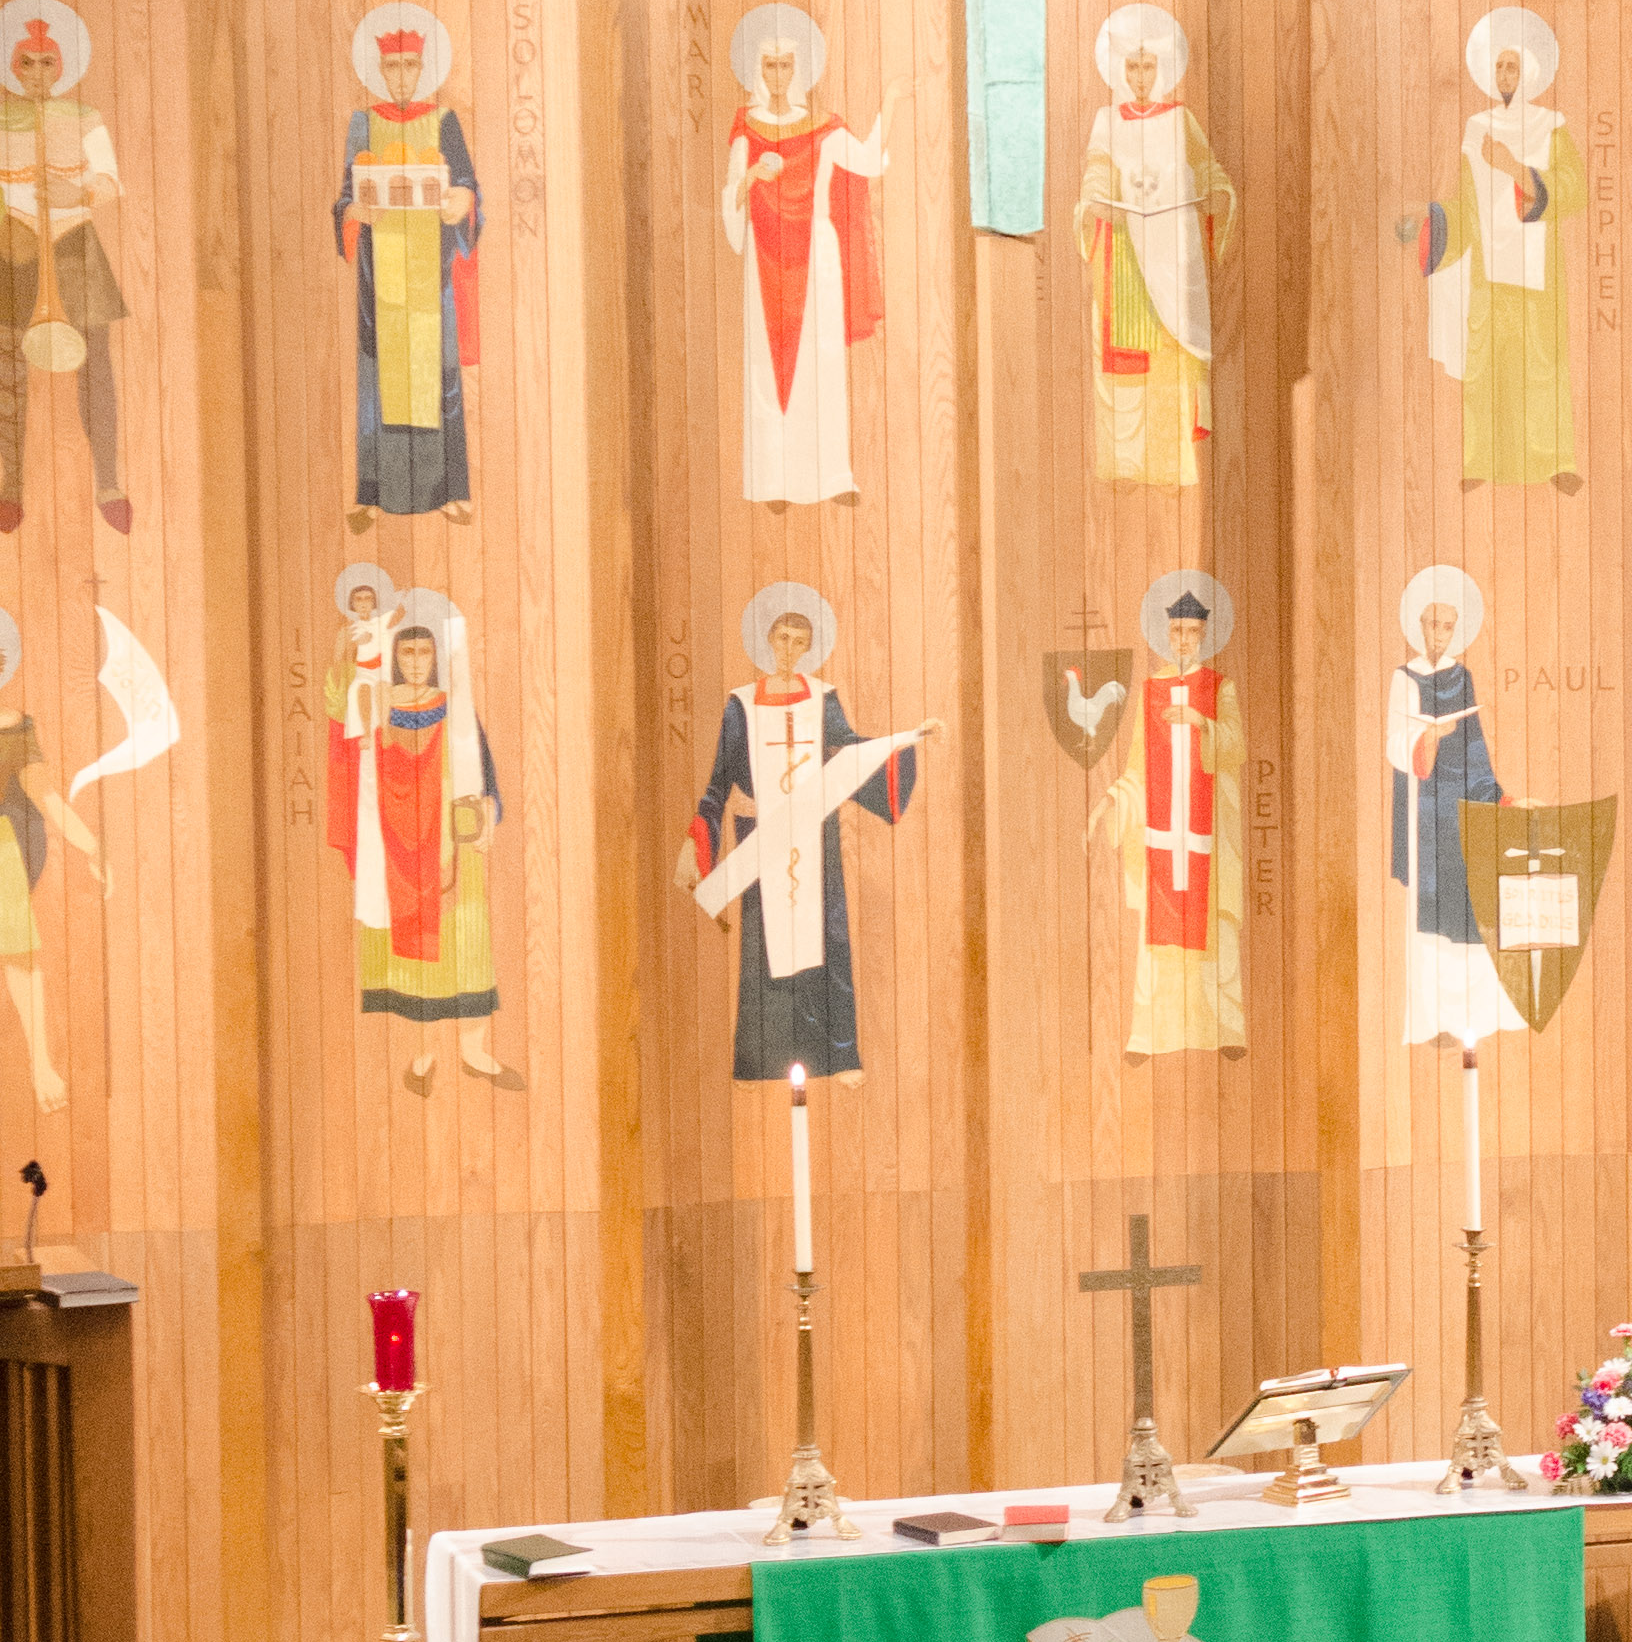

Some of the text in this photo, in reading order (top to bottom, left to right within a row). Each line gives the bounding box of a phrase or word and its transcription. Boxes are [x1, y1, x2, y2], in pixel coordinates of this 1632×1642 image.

[513, 4, 541, 237] SOLOMON
[686, 4, 711, 133] MARY
[1595, 110, 1617, 332] STEPHEN
[287, 628, 313, 826] ISAIAH
[667, 620, 690, 745] JOHN
[1504, 666, 1615, 692] PAUL
[1253, 760, 1278, 916] PETER
